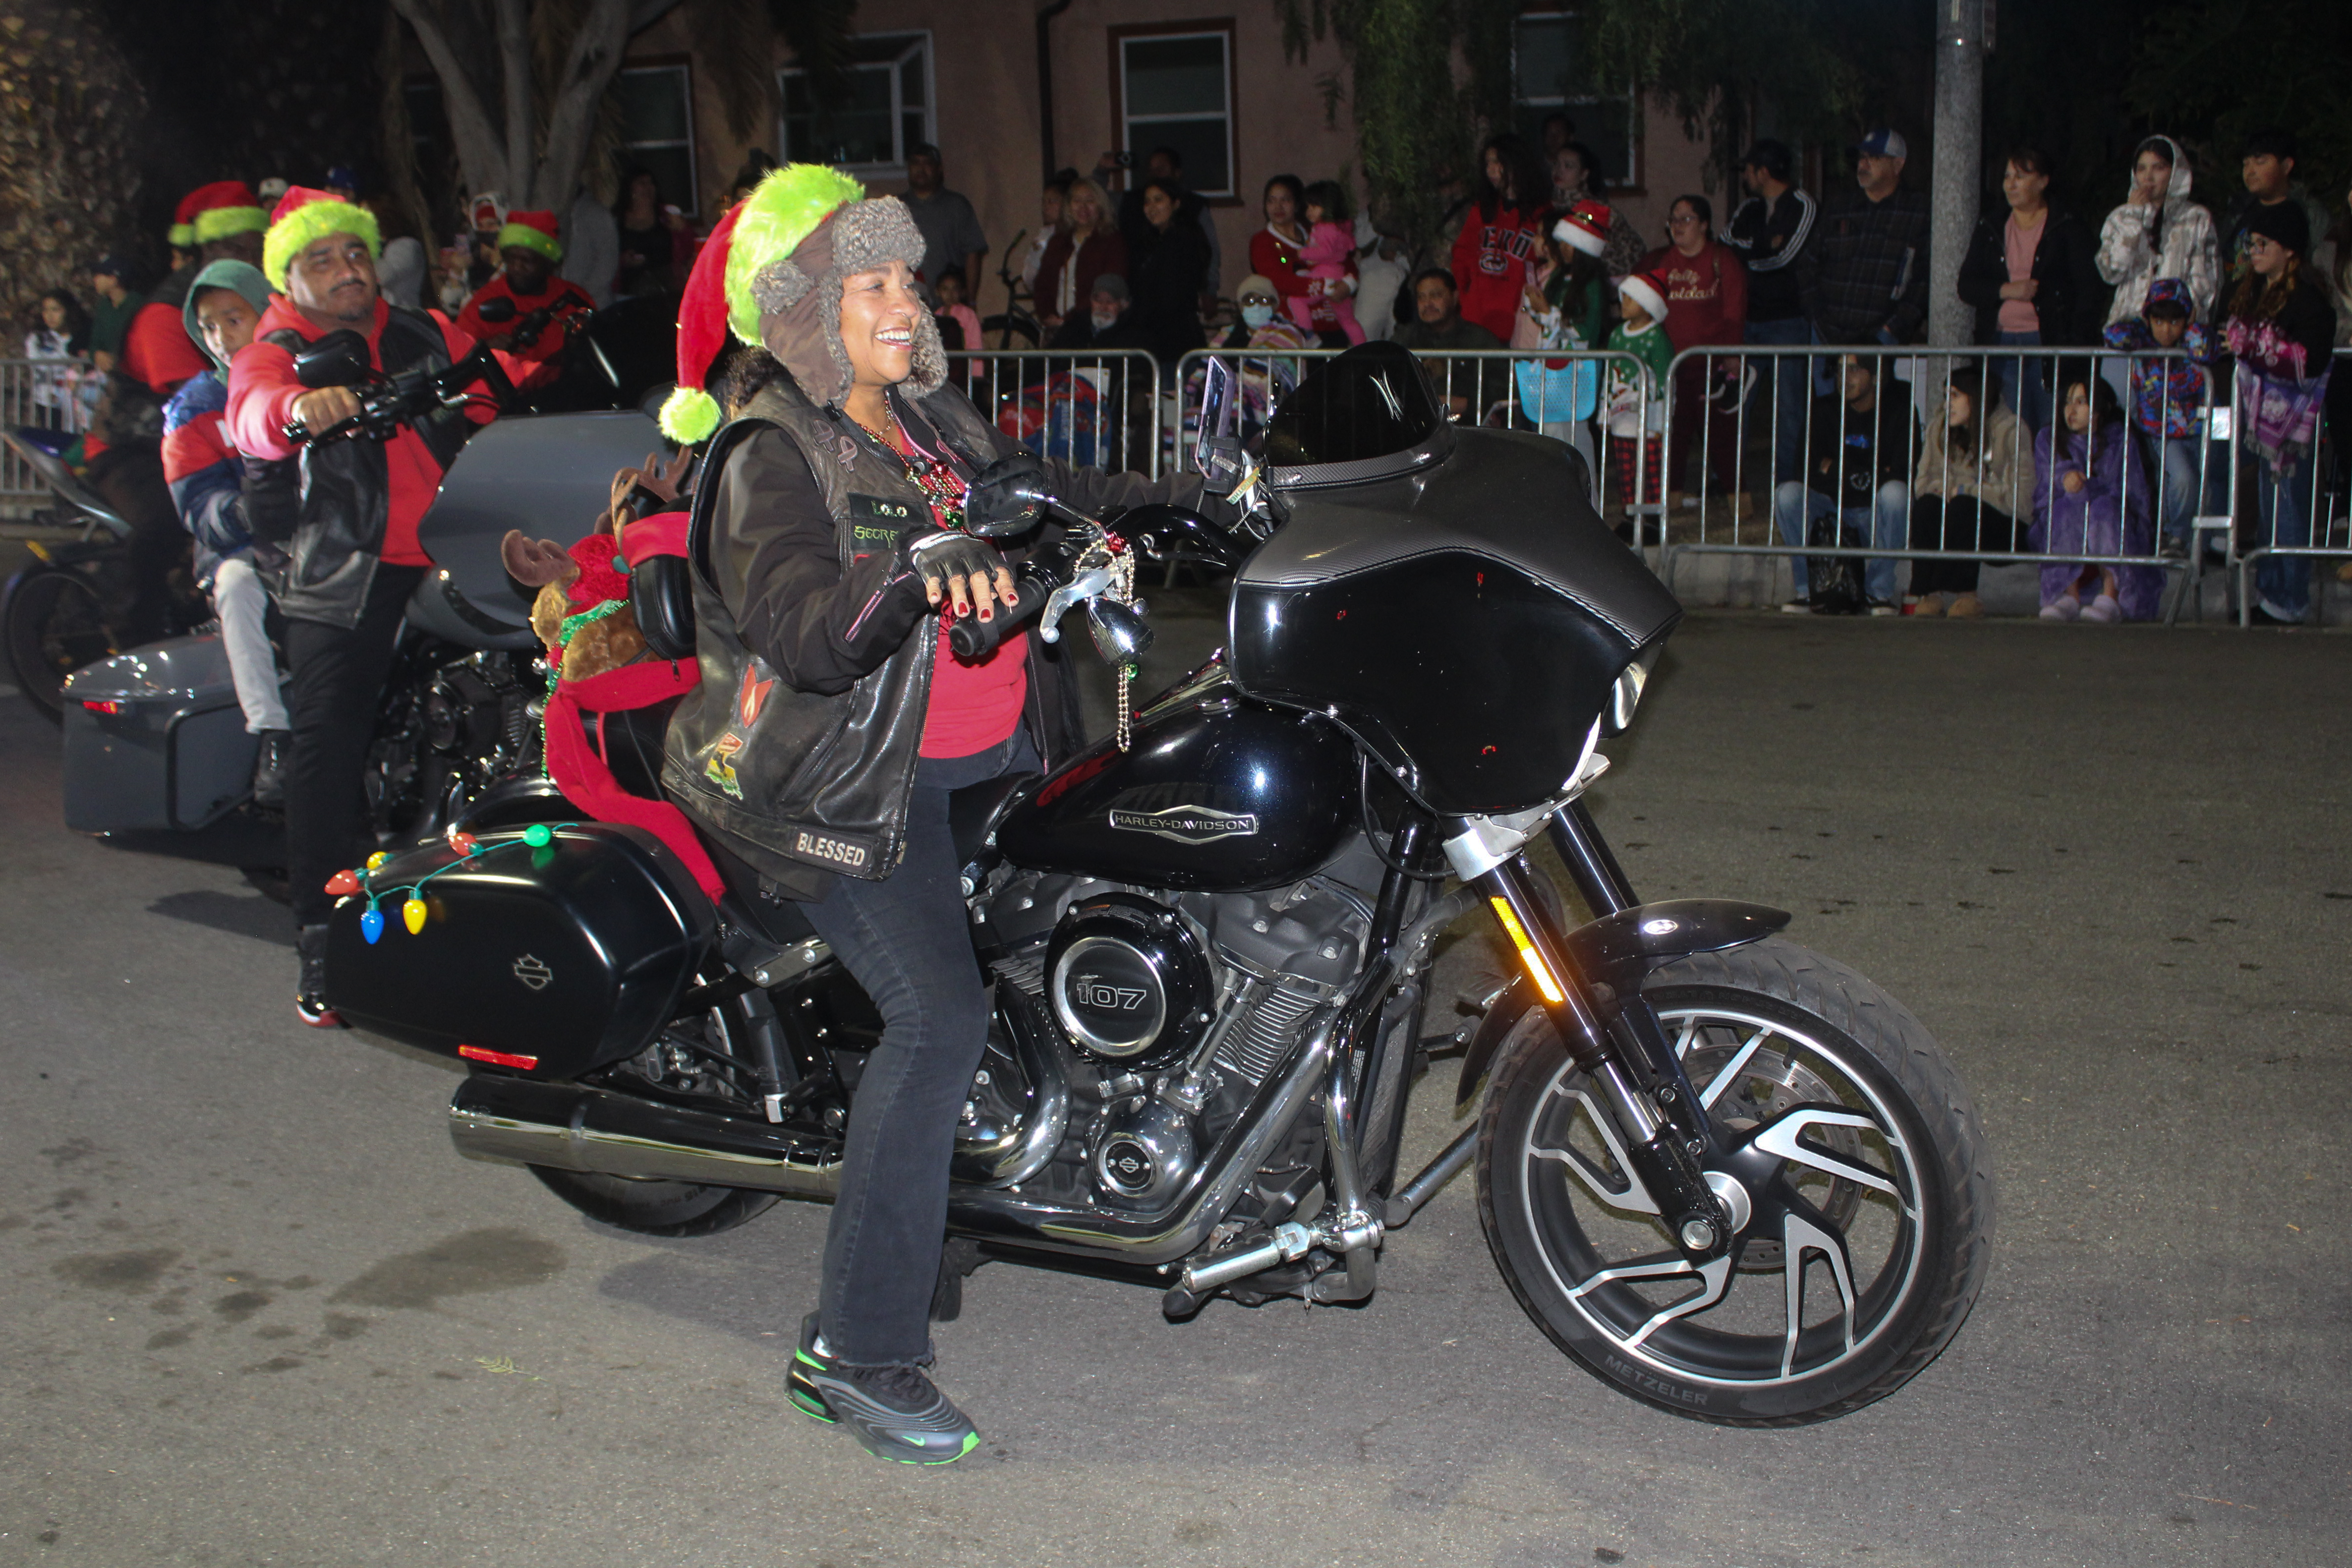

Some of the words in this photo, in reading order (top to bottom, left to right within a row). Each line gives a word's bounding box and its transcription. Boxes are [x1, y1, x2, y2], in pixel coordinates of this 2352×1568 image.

[1114, 815, 1251, 830] HARLEY-DAVIDSON
[796, 832, 865, 867] BLESSED
[1076, 983, 1147, 1010] 107
[1604, 1354, 1709, 1406] METZELER
